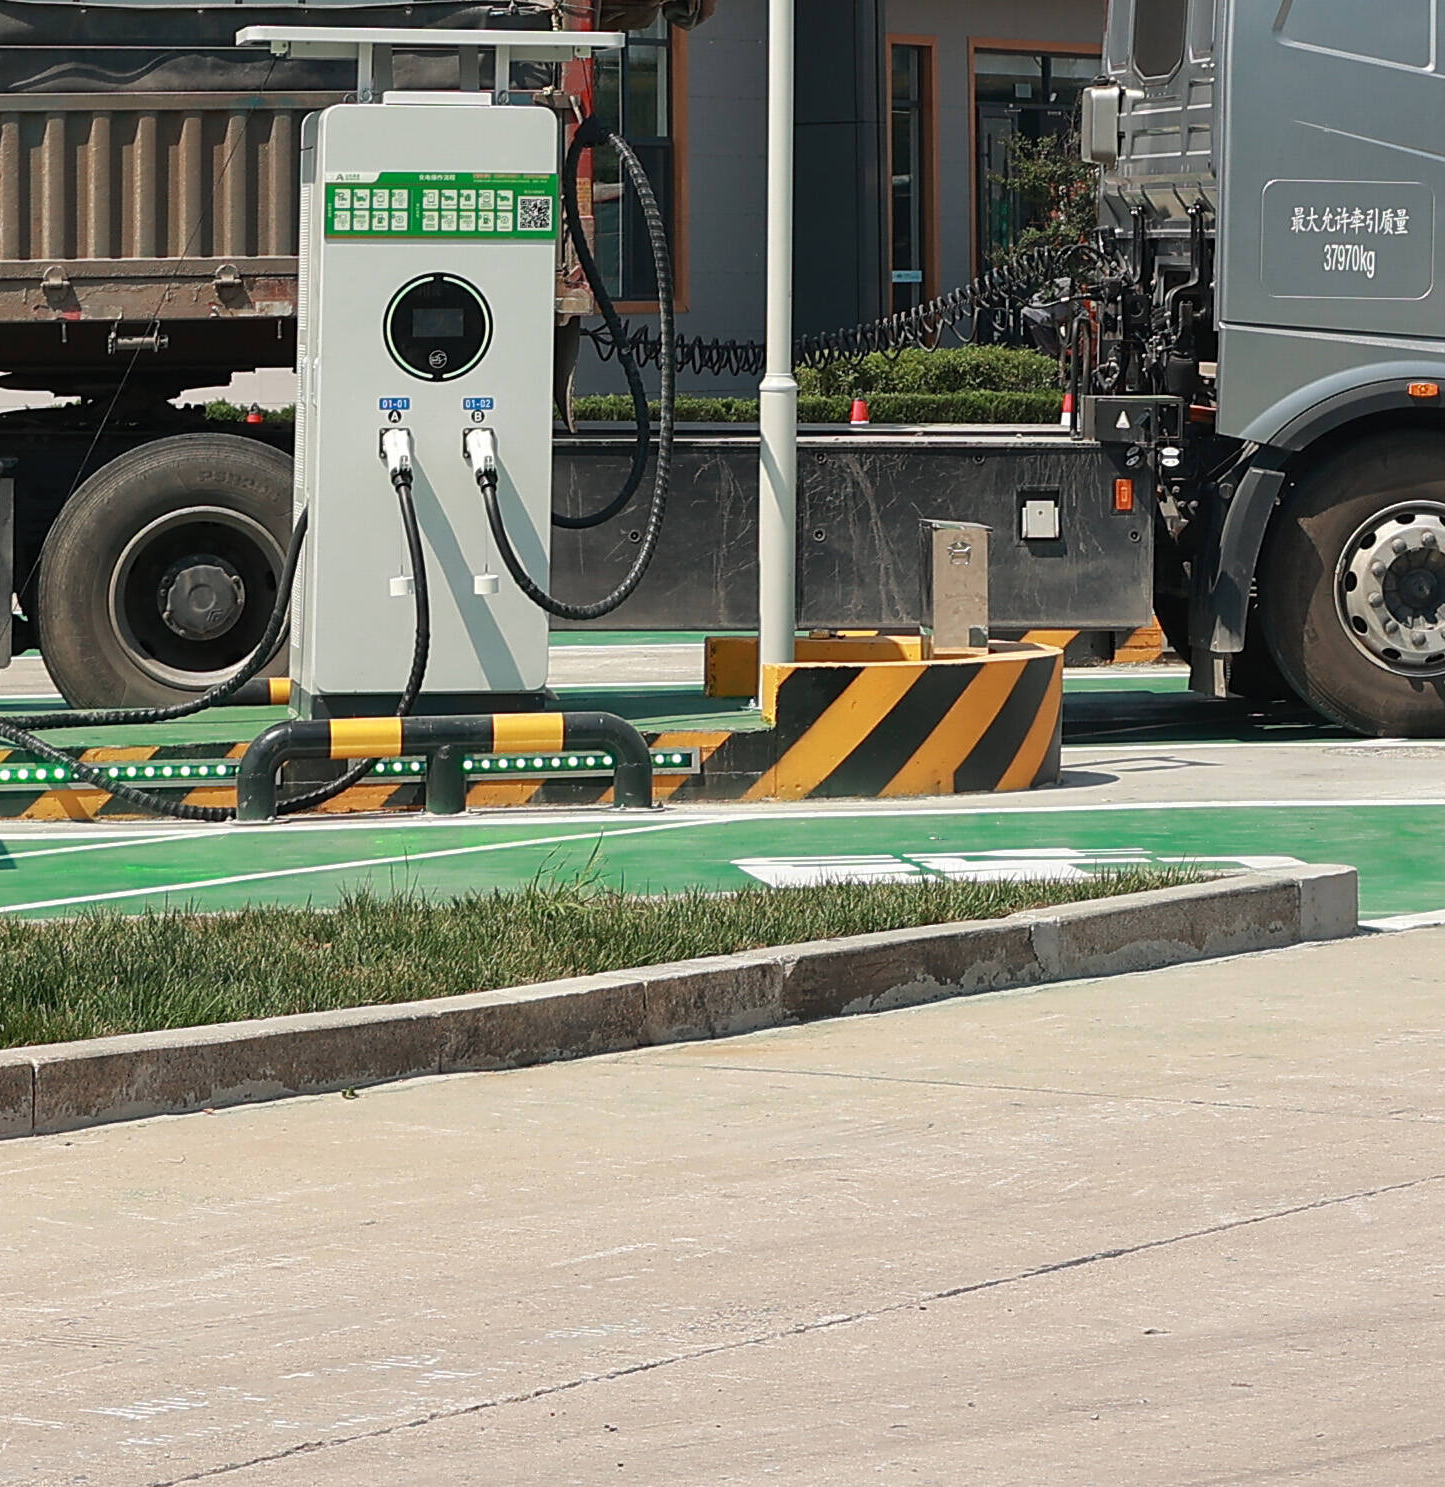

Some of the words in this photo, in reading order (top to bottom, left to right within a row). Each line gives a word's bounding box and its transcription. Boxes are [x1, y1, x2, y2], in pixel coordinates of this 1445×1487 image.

[1290, 207, 1410, 235] 最大允许牵引质量
[1323, 244, 1375, 279] 37970kg
[382, 399, 407, 409] 01-01
[465, 399, 491, 409] 01-02
[390, 411, 400, 422] A
[474, 411, 482, 422] B
